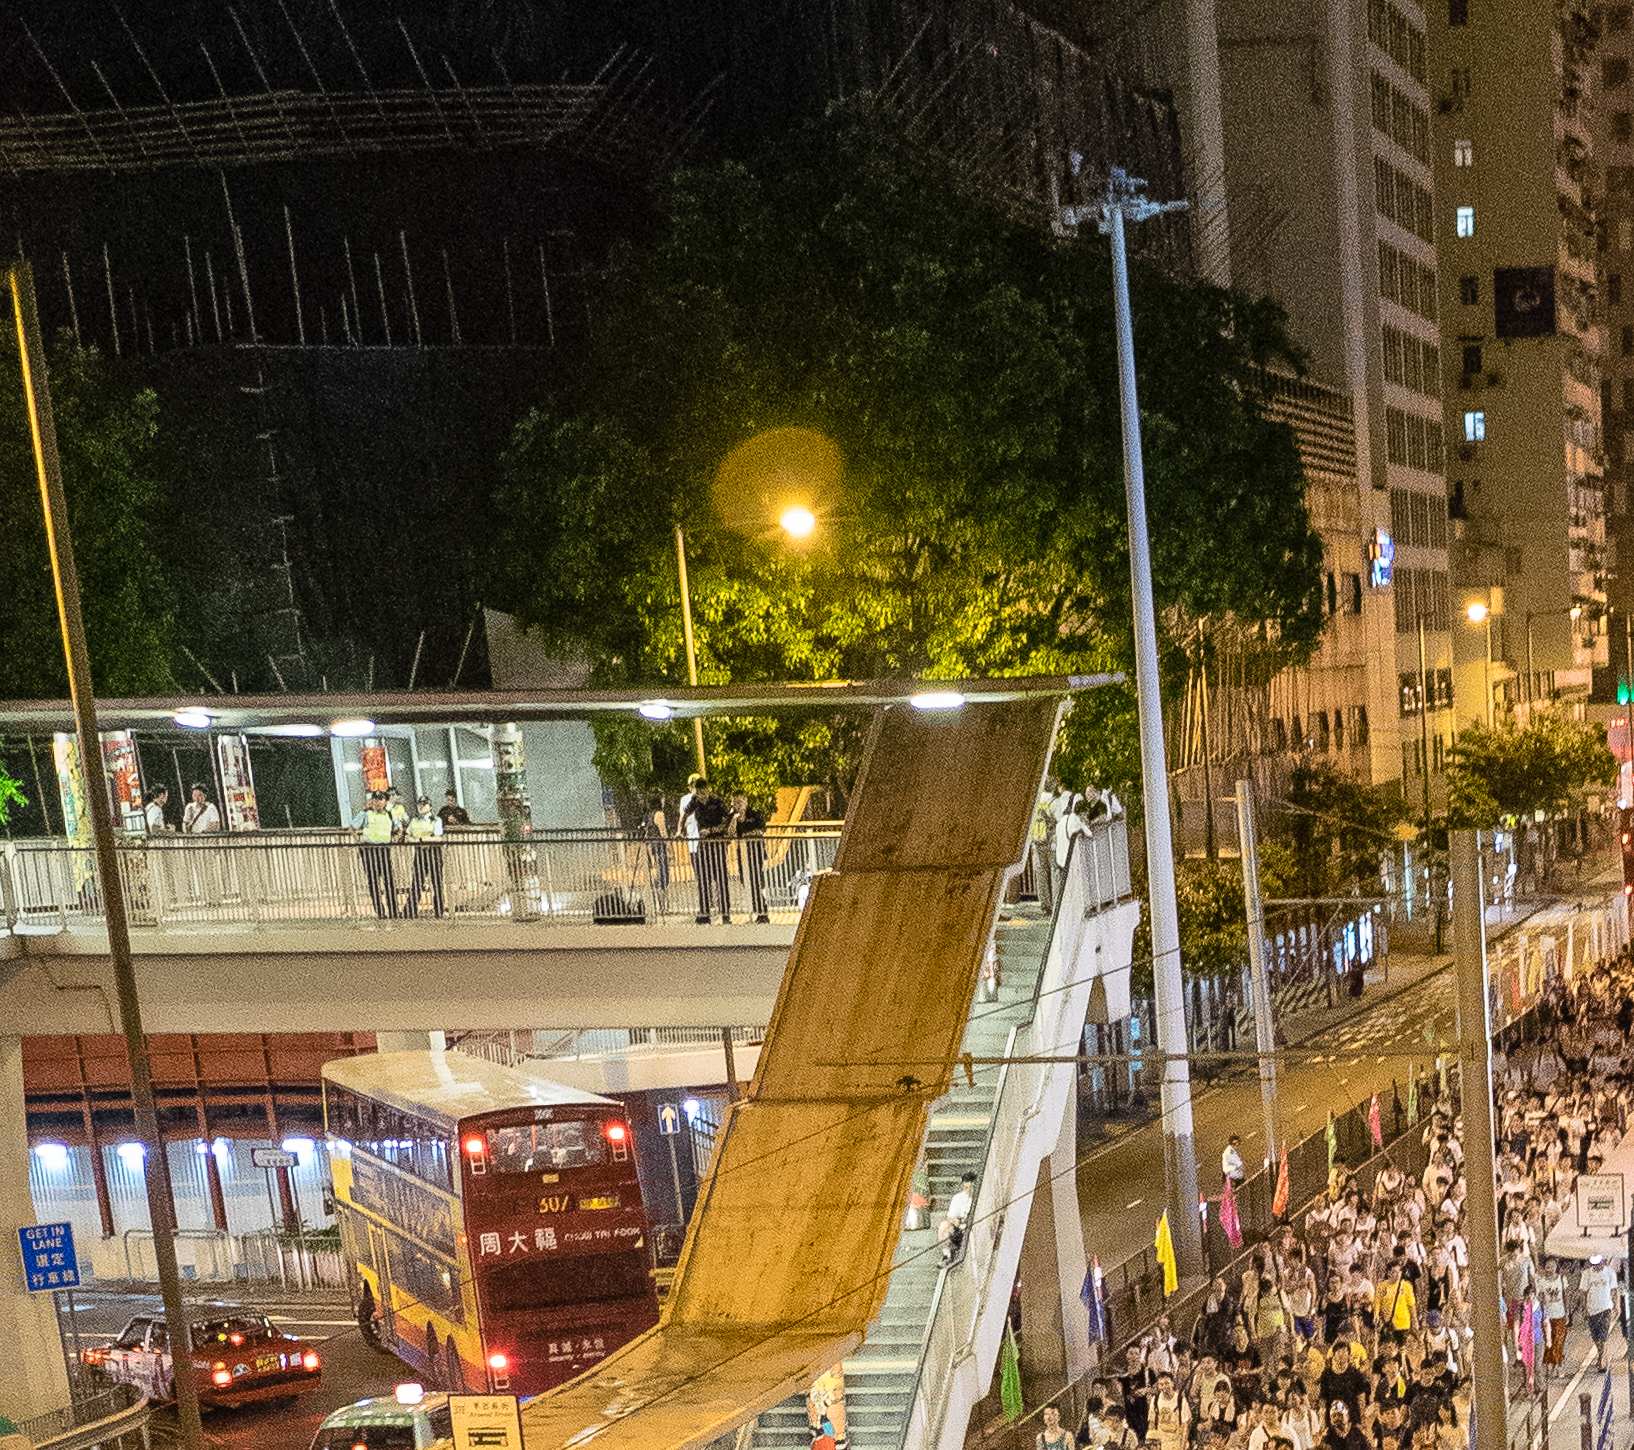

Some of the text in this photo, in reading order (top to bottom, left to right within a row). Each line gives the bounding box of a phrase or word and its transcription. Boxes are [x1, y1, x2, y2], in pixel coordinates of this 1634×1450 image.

[26, 1225, 65, 1240] GET IN
[32, 1238, 63, 1250] LANE
[479, 1228, 558, 1257] 周大福
